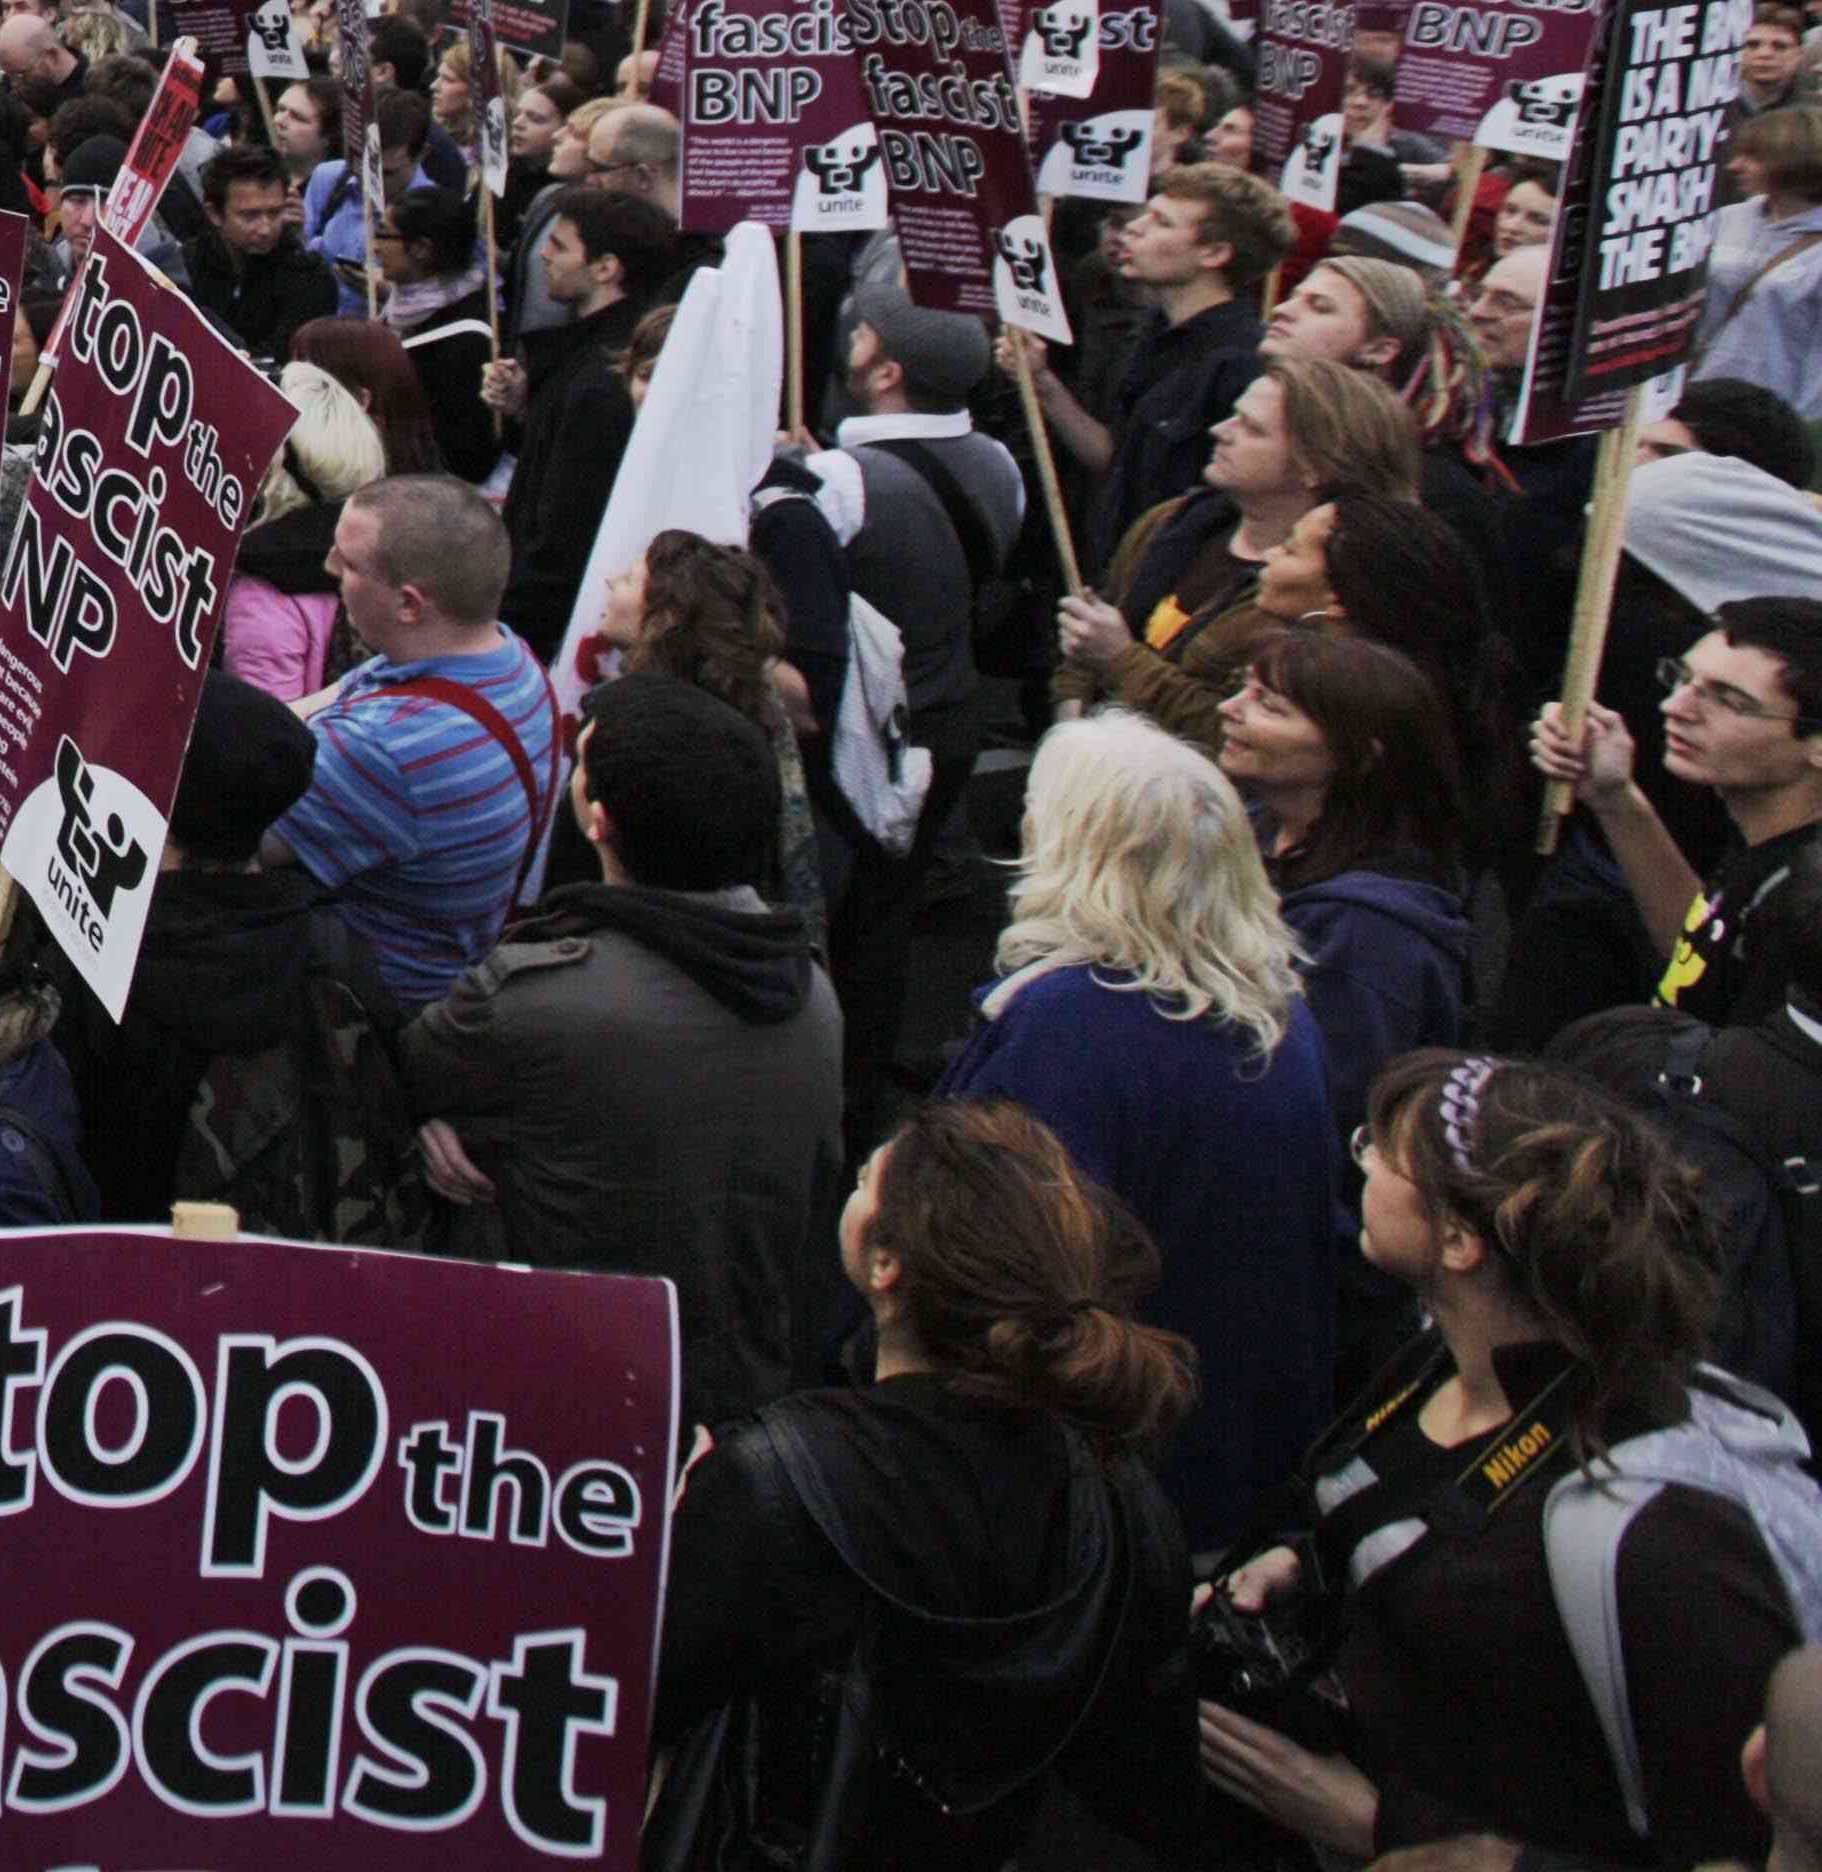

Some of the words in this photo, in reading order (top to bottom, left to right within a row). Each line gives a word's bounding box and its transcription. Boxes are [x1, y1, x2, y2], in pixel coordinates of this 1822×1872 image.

[693, 0, 854, 58] fascis
[1406, 2, 1543, 59] BNP
[691, 67, 821, 126] BNP
[866, 52, 1019, 130] fascist
[880, 130, 984, 196] BNP
[818, 195, 864, 214] unite
[183, 417, 245, 531] the
[46, 856, 106, 954] unite
[398, 1410, 641, 1558] the
[1483, 1422, 1552, 1488] Nikon
